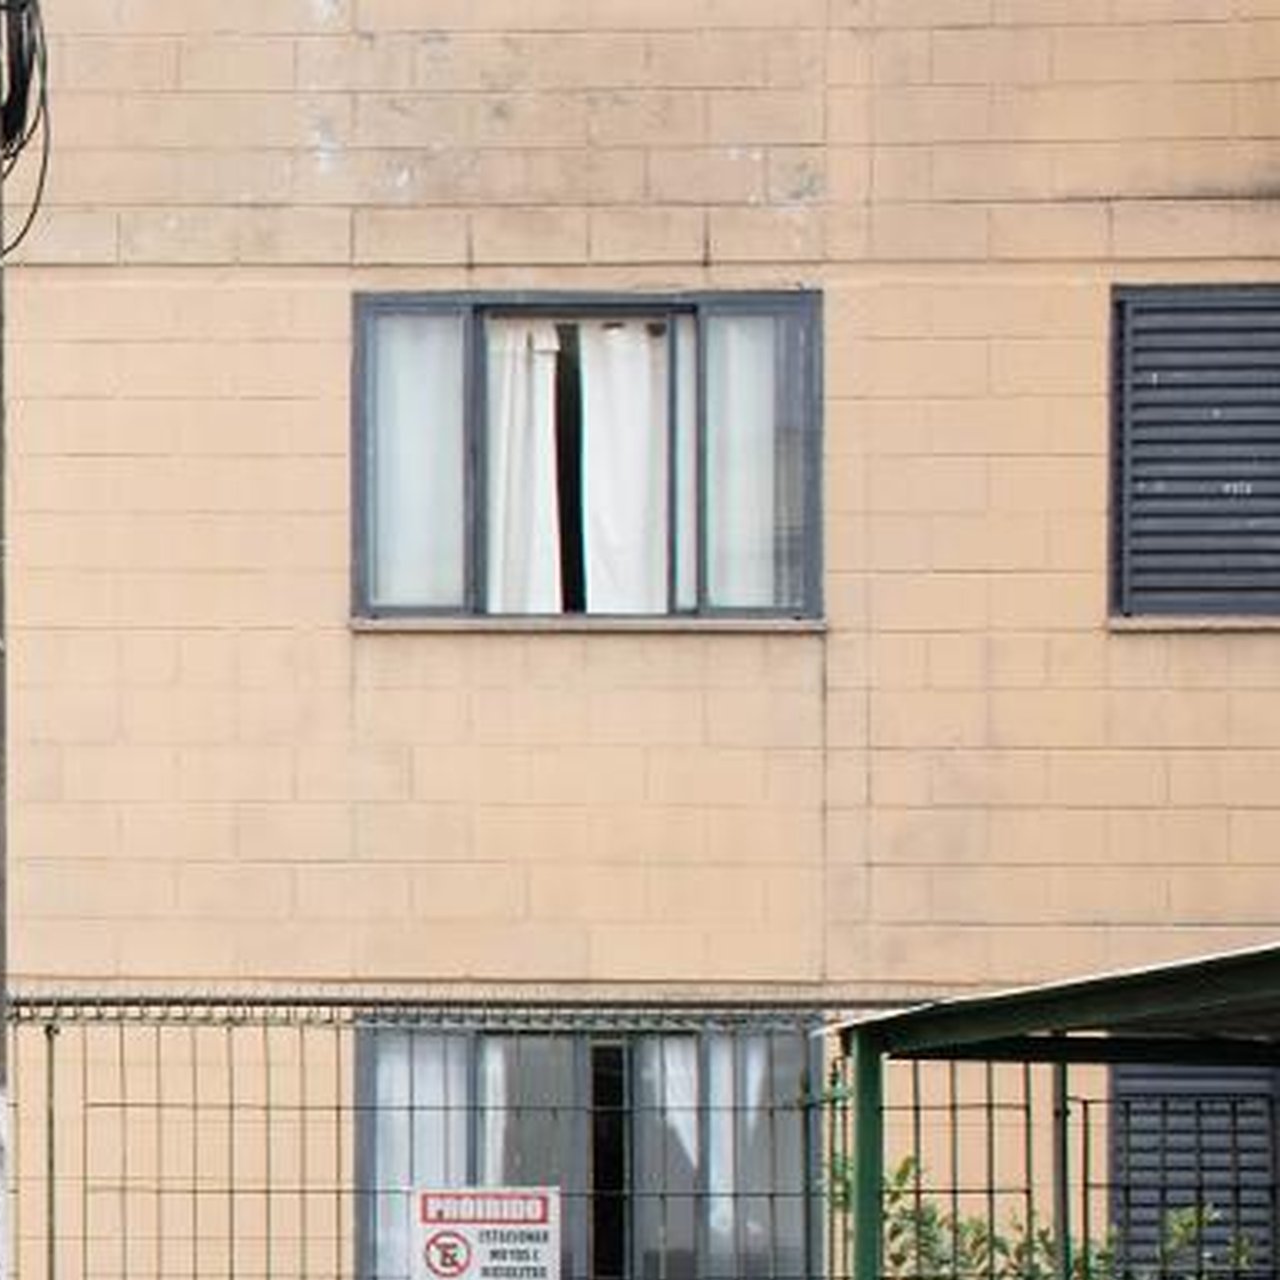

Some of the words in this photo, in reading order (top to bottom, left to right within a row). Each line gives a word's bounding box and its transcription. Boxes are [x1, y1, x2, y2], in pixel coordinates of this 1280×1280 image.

[427, 1197, 544, 1221] PROIBIDO
[479, 1230, 549, 1244] ESTACIONAR
[490, 1249, 531, 1262] MOTOS
